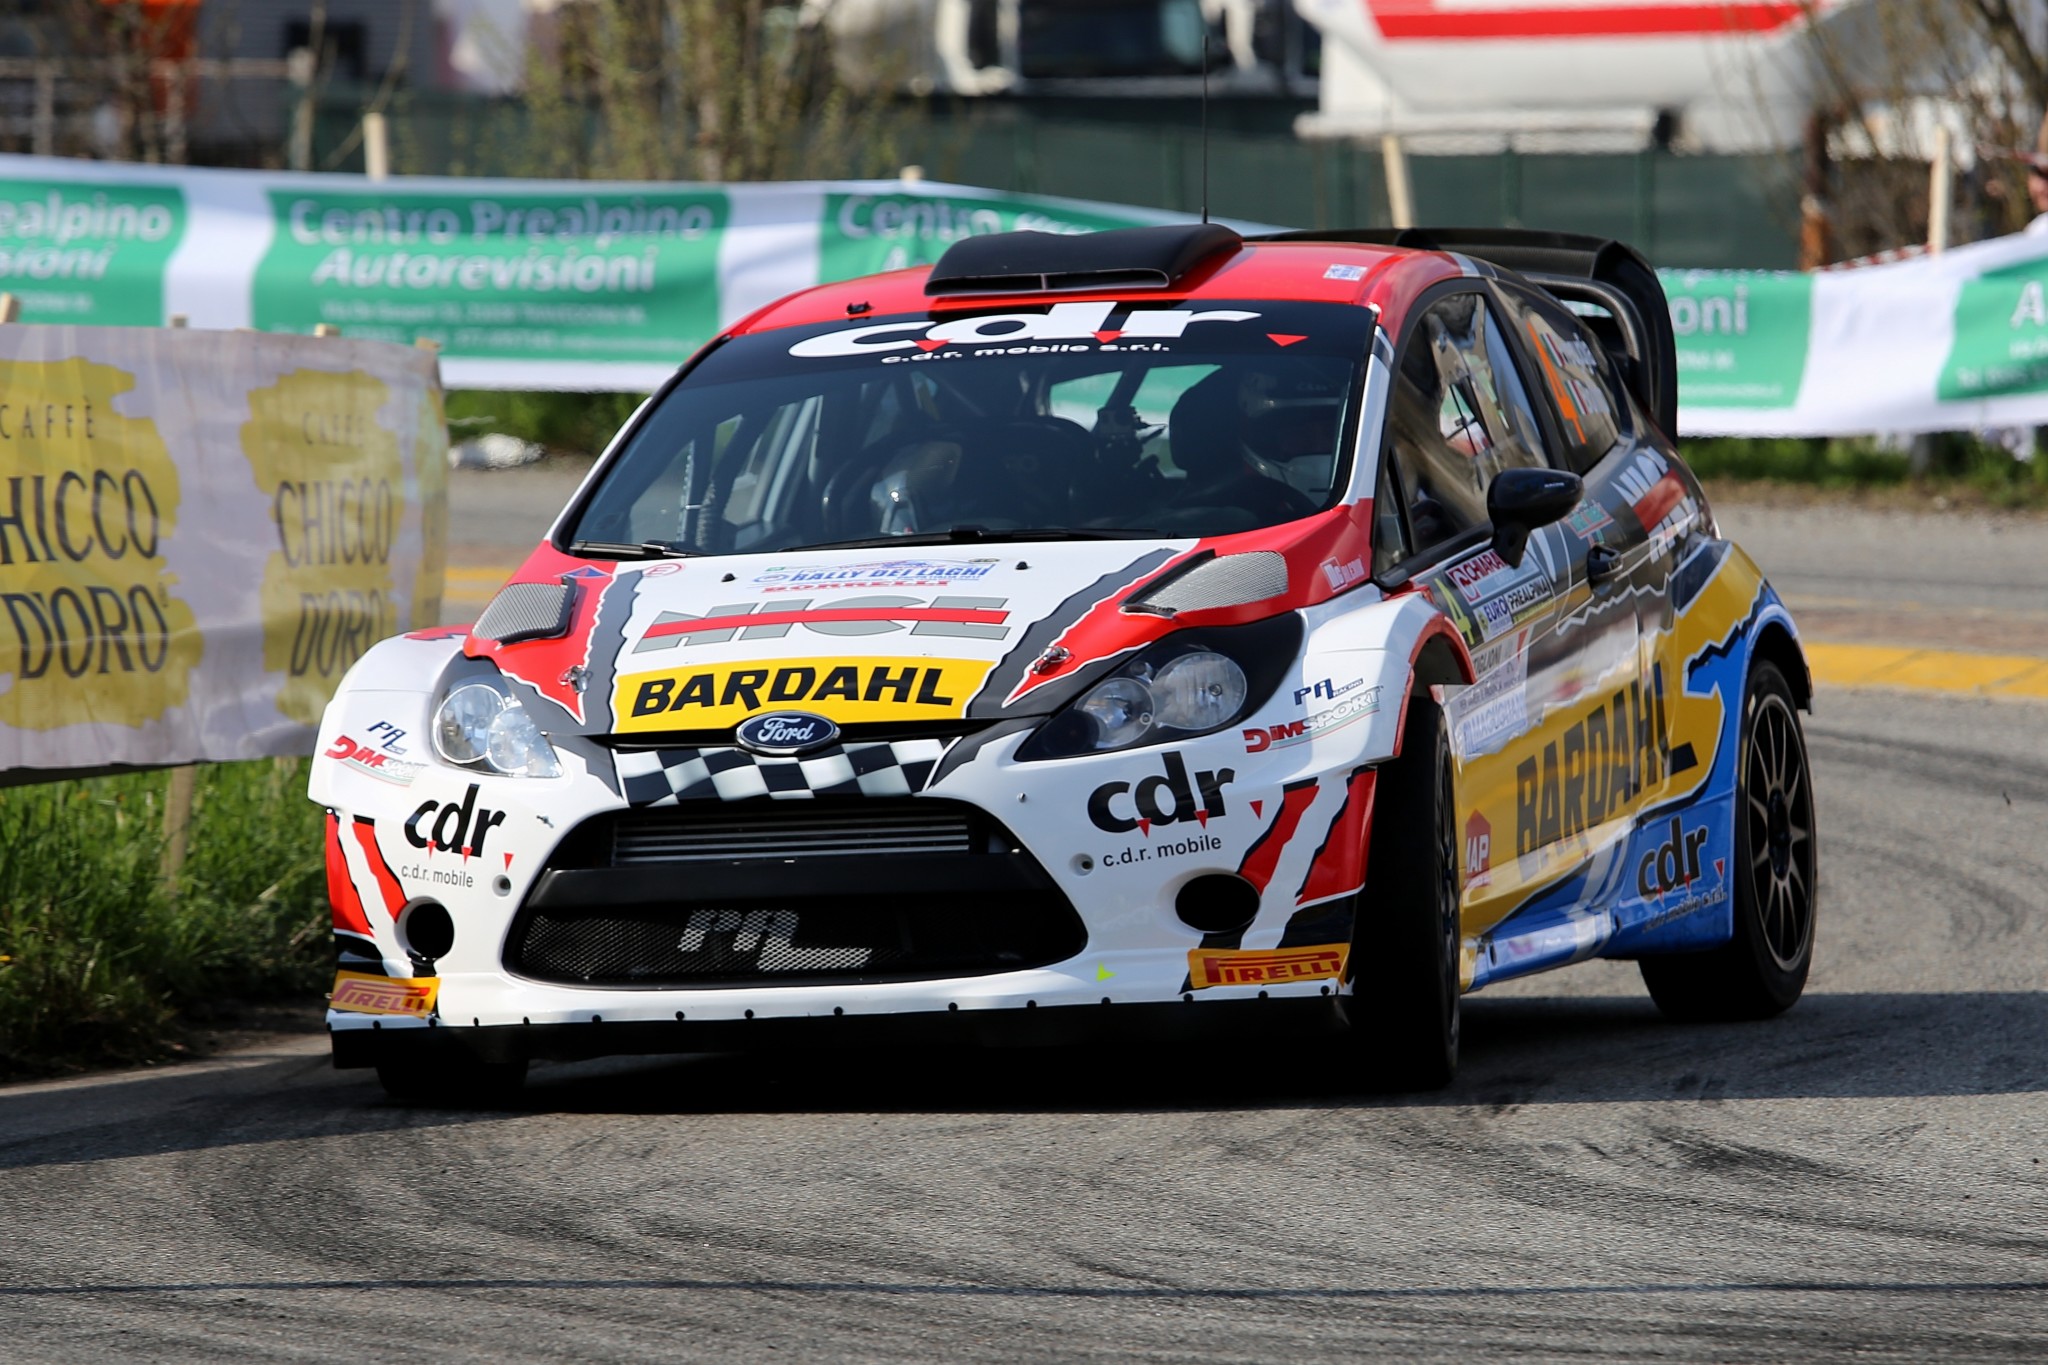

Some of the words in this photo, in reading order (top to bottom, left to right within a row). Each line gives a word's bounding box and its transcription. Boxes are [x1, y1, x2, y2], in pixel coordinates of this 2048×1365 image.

[290, 198, 461, 246] Centro
[471, 197, 713, 251] Prealpino
[312, 245, 660, 292] Autorevisioni
[788, 301, 1262, 358] cdr
[974, 343, 1091, 358] mobile
[275, 478, 393, 569] CHICCO
[789, 569, 865, 582] RALLY
[869, 567, 913, 578] DEI
[915, 564, 996, 577] LAGHI
[1434, 577, 1475, 646] 4
[1483, 595, 1509, 623] EURO
[631, 666, 954, 718] BARDAHL
[757, 715, 814, 744] Ford
[1087, 750, 1236, 834] cdr
[1516, 660, 1699, 883] BARDAHL
[404, 782, 507, 858] cdr
[401, 863, 430, 881] c.d.r.
[432, 869, 474, 888] mobile
[1103, 846, 1152, 868] c.d.r.
[1156, 834, 1222, 859] mobile
[1638, 815, 1708, 902] cdr
[1203, 951, 1341, 984] PIRELLI
[332, 979, 431, 1013] PIRELLI
